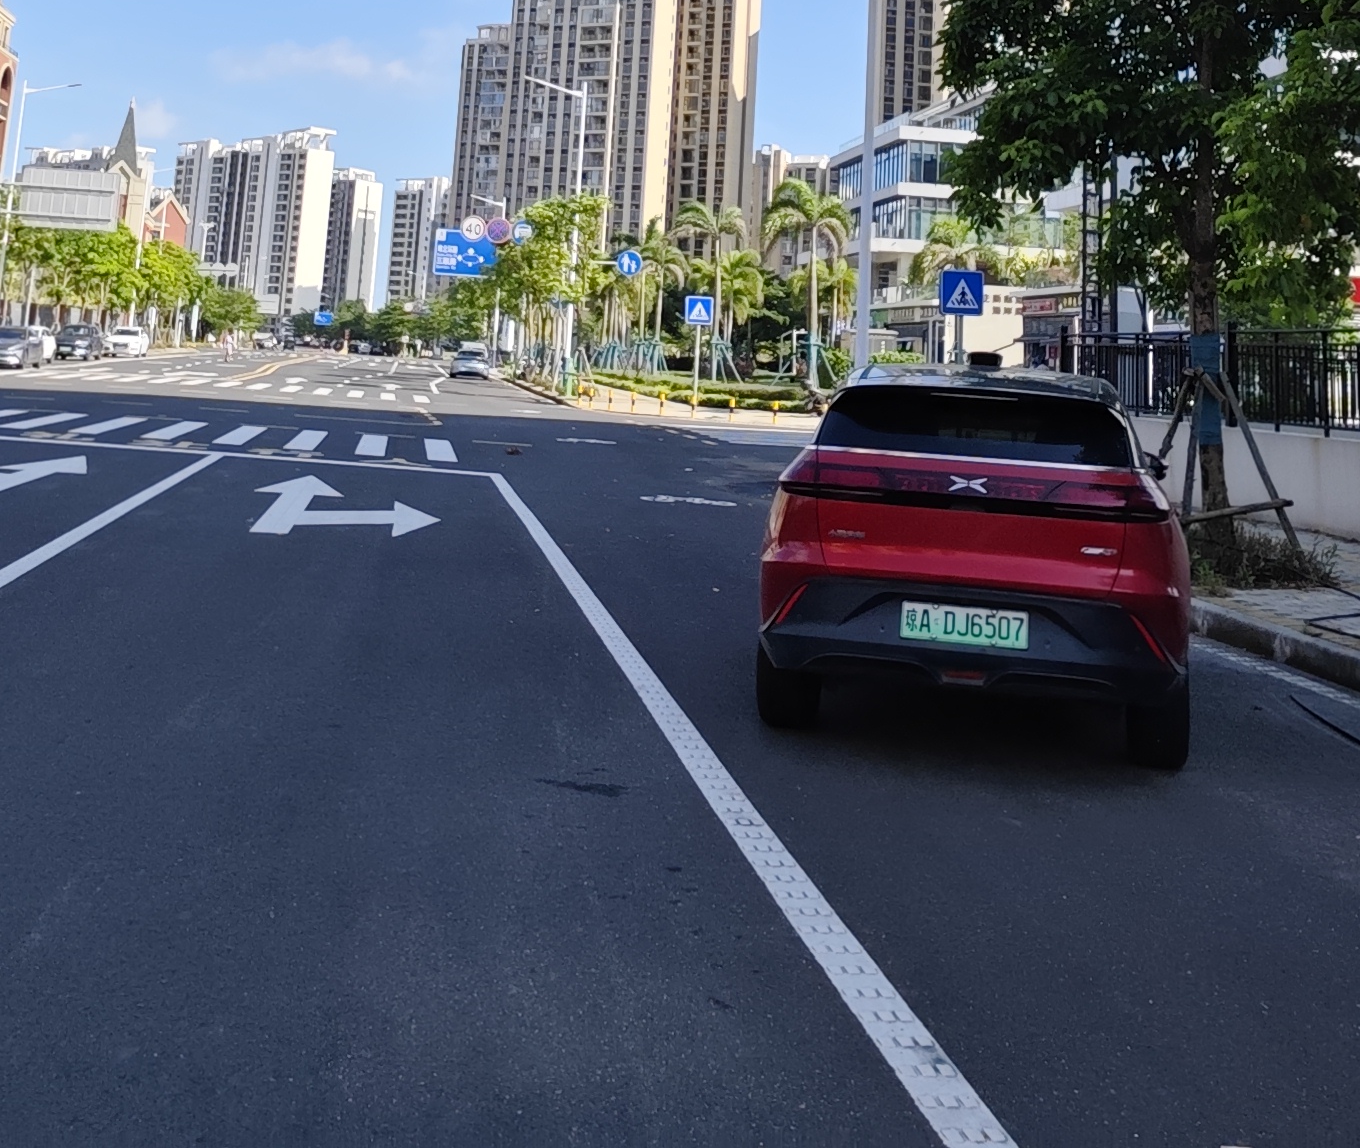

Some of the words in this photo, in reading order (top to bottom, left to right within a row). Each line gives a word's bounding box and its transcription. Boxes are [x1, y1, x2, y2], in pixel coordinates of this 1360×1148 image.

[466, 224, 481, 235] 40
[905, 608, 931, 633] 琼A
[943, 611, 1024, 641] DJ6507
